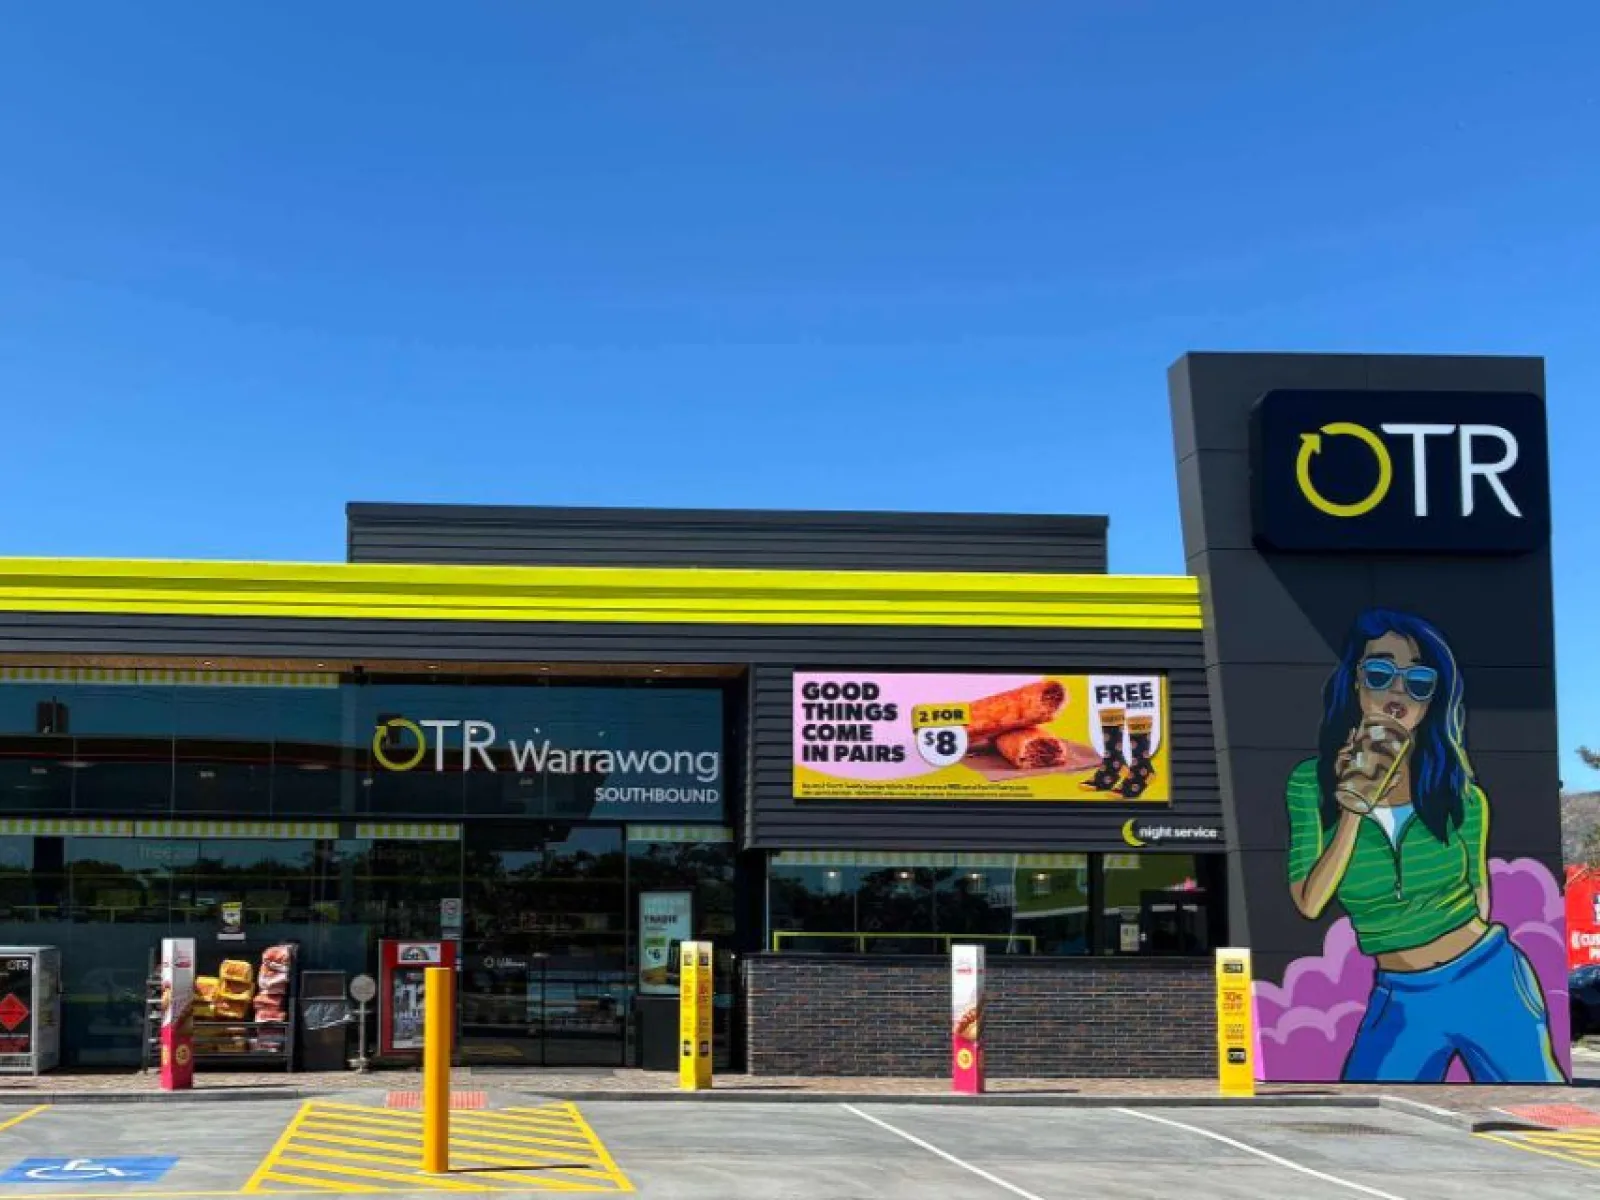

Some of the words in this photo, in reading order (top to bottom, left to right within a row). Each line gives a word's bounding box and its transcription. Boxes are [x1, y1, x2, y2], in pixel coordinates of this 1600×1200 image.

[1296, 422, 1522, 517] OTR
[802, 682, 880, 701] GOOD
[1095, 682, 1153, 704] FREE
[802, 703, 898, 721] THINGS
[919, 711, 929, 722] 2
[932, 709, 964, 721] FOR
[802, 724, 873, 742] COME
[373, 719, 496, 771] OTR
[509, 739, 720, 781] Warrawong
[802, 745, 829, 762] IN
[834, 744, 906, 763] PAIRS
[595, 787, 720, 804] SOUTHBOUND
[1139, 825, 1172, 839] night
[1174, 826, 1218, 838] service
